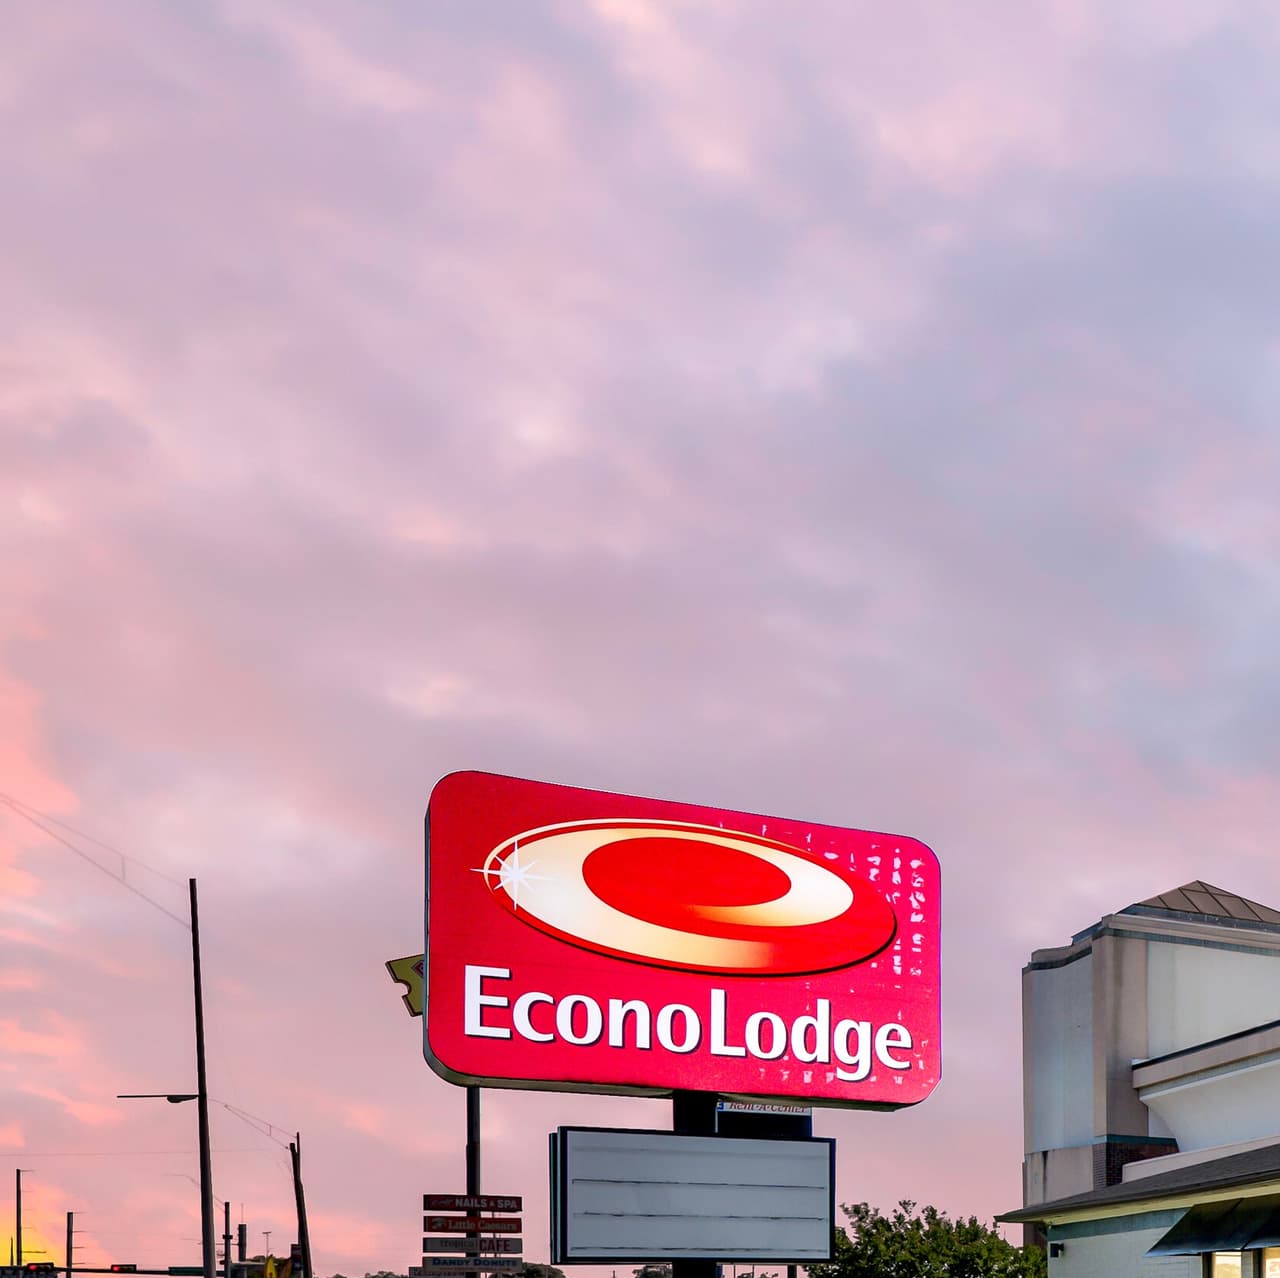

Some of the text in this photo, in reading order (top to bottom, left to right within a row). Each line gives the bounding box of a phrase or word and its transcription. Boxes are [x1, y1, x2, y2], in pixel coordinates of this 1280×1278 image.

[464, 965, 914, 1082] EconoLodge
[455, 1199, 487, 1208] NAILS
[497, 1200, 517, 1209] SPA
[480, 1239, 511, 1252] CAFE
